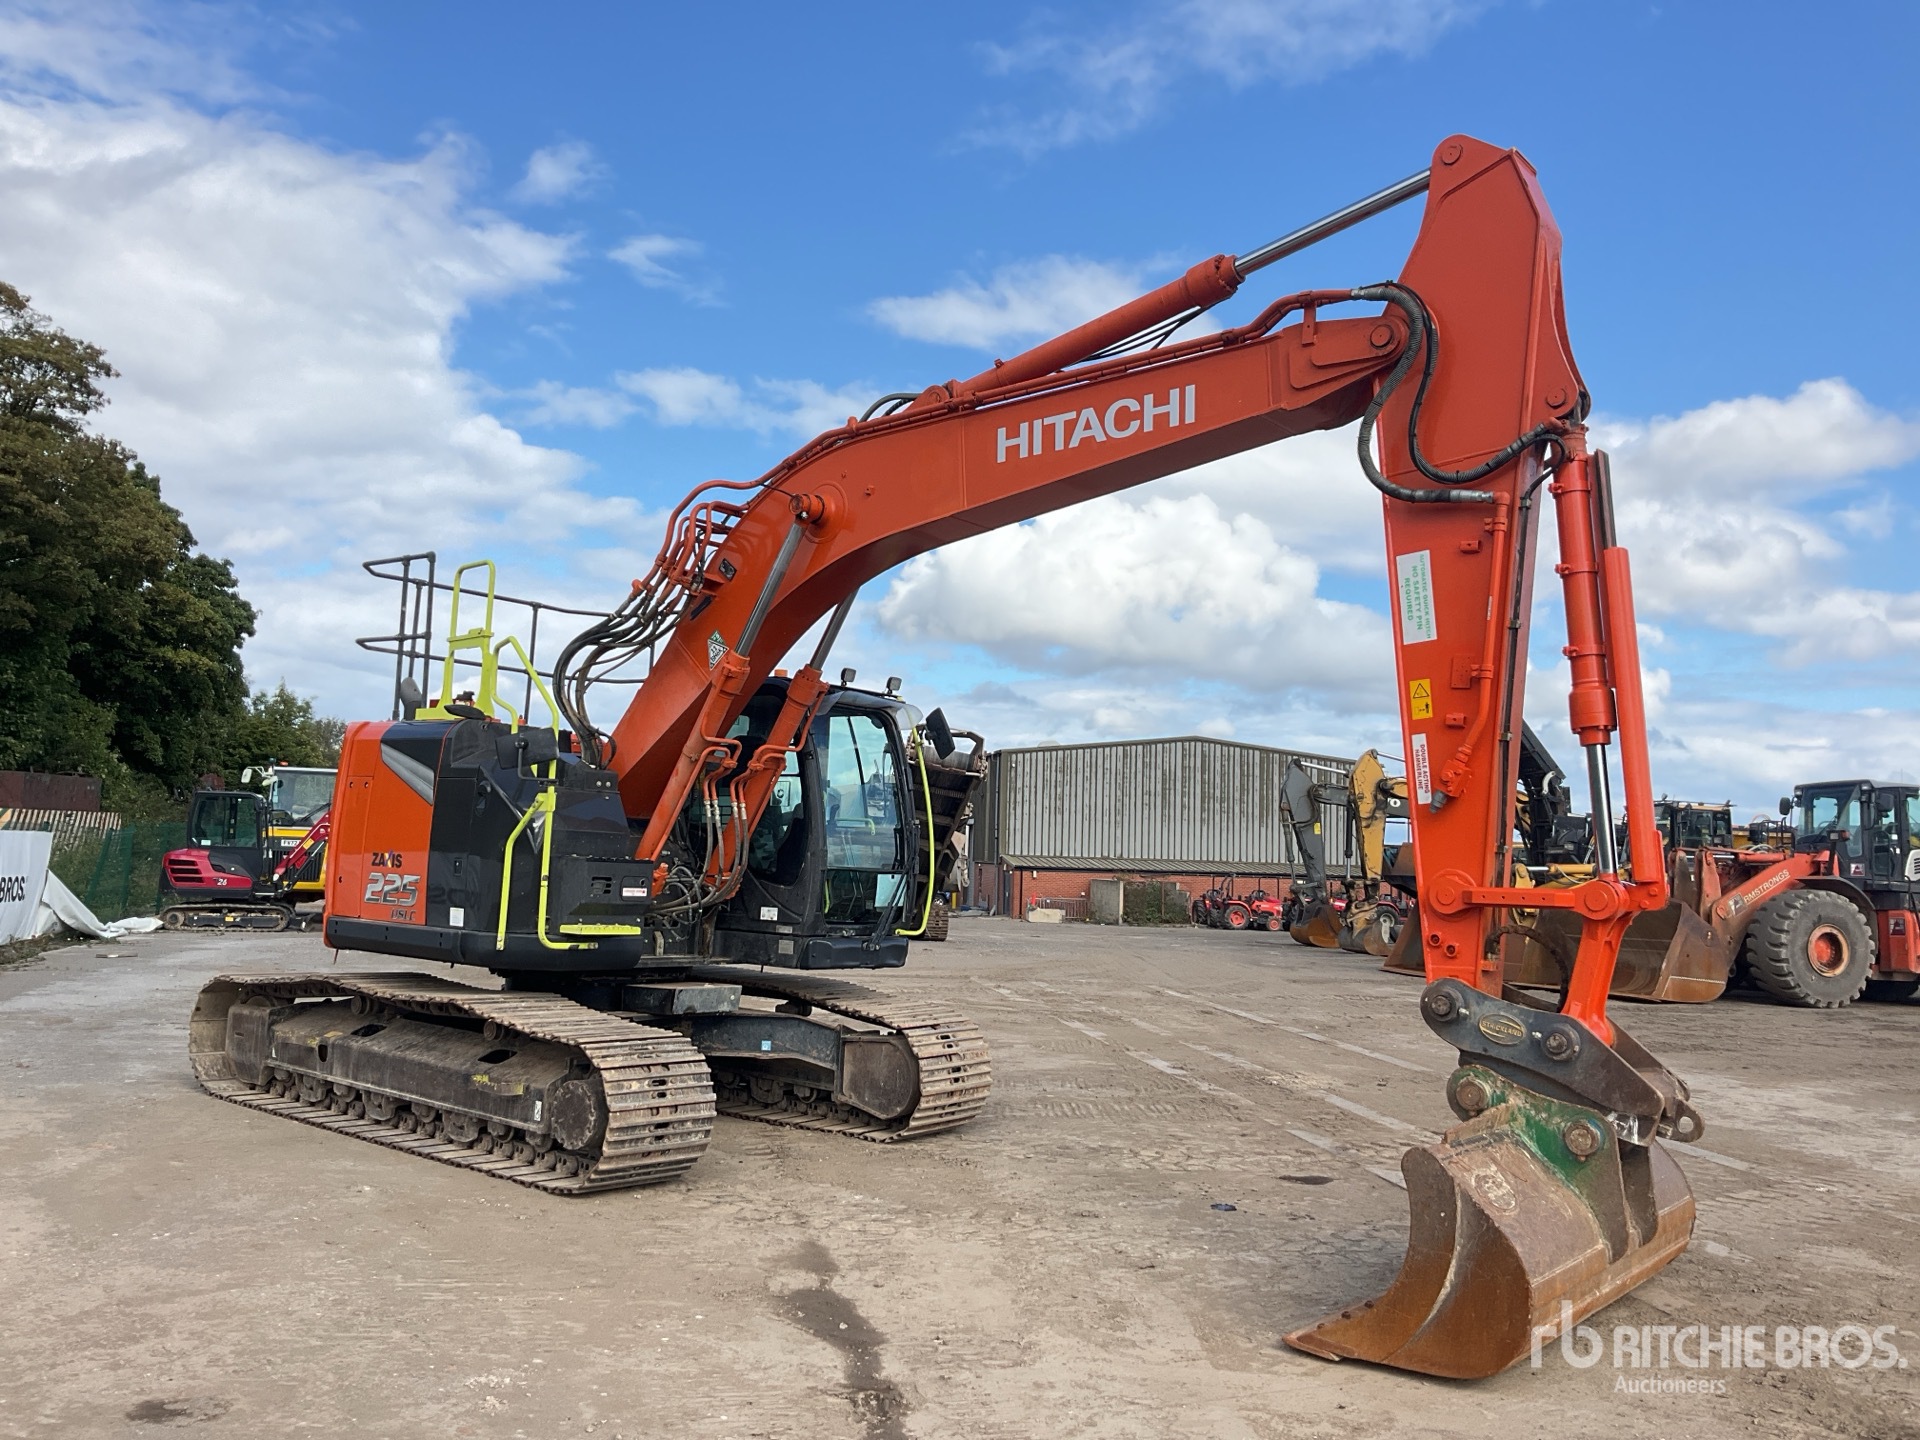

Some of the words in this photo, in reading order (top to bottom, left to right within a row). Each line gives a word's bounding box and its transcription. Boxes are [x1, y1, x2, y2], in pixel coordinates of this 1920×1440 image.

[997, 384, 1195, 463] HITACHI
[1411, 565, 1419, 578] NO
[1419, 554, 1428, 592] AUTOMATIC
[1404, 577, 1414, 621] REQUIRED
[1412, 580, 1421, 612] SAFETY
[1422, 594, 1430, 616] QUICK
[1415, 749, 1423, 790] HAMMERLINE
[371, 850, 402, 868] ZAXIS
[0, 876, 25, 902] BROS.
[364, 872, 420, 907] 225
[1482, 1020, 1522, 1037] STRICKLAND
